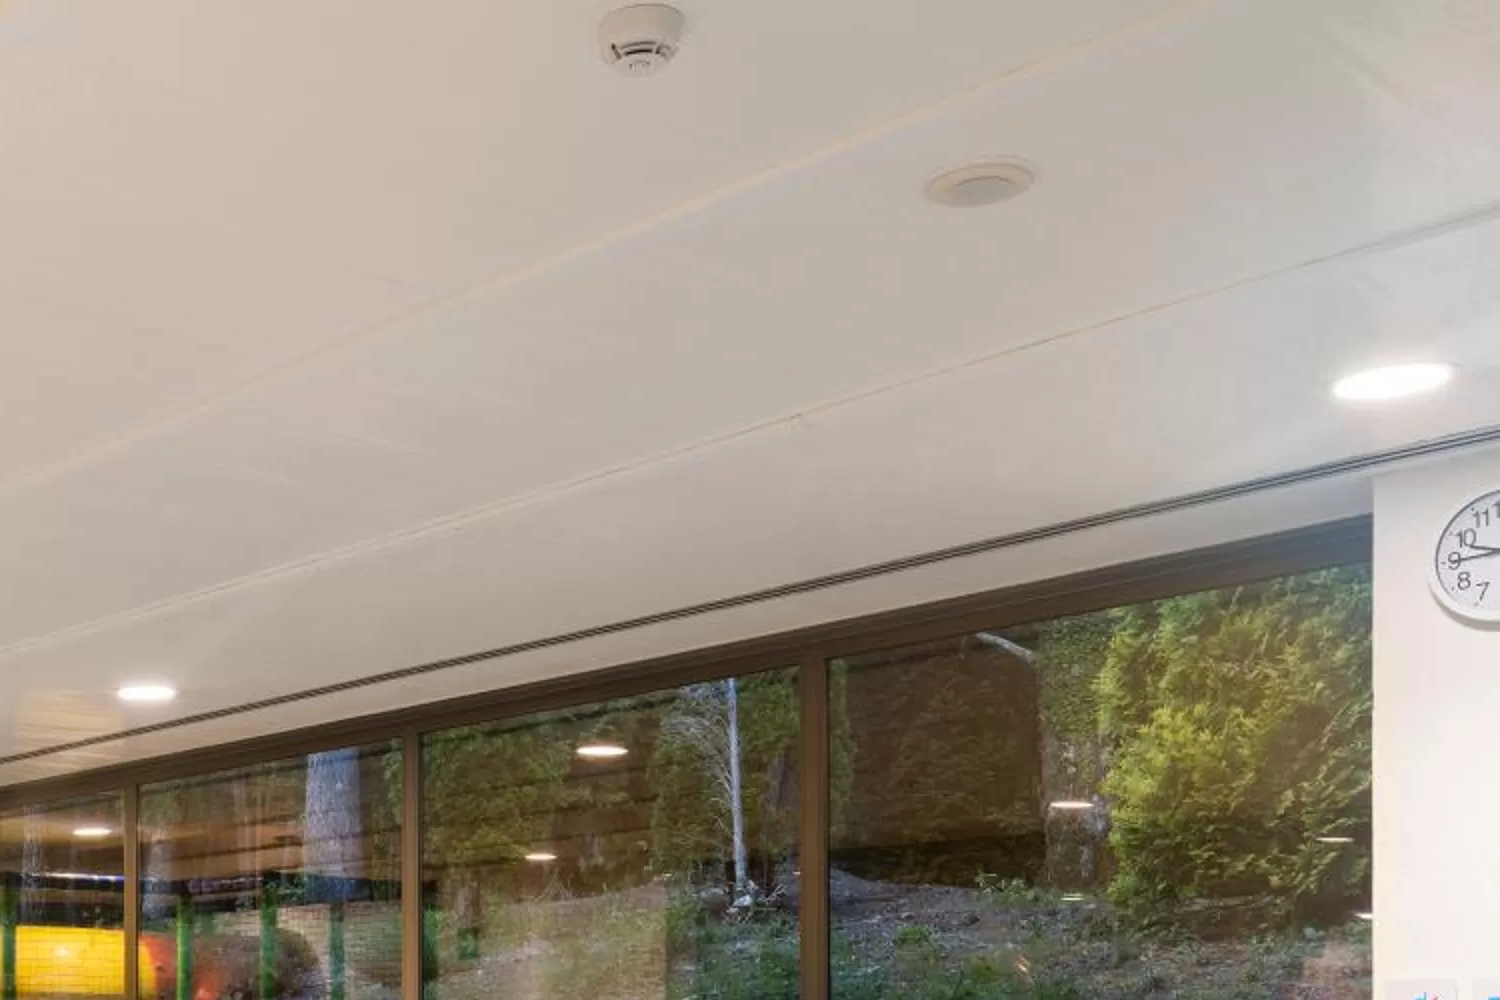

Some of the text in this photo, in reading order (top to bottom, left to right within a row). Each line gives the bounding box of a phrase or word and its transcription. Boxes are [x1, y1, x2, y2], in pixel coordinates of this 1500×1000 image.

[1471, 507, 1490, 529] 11
[1456, 527, 1477, 548] 10
[1448, 551, 1461, 571] 9
[1457, 571, 1471, 590] 8
[1475, 581, 1490, 602] 7
